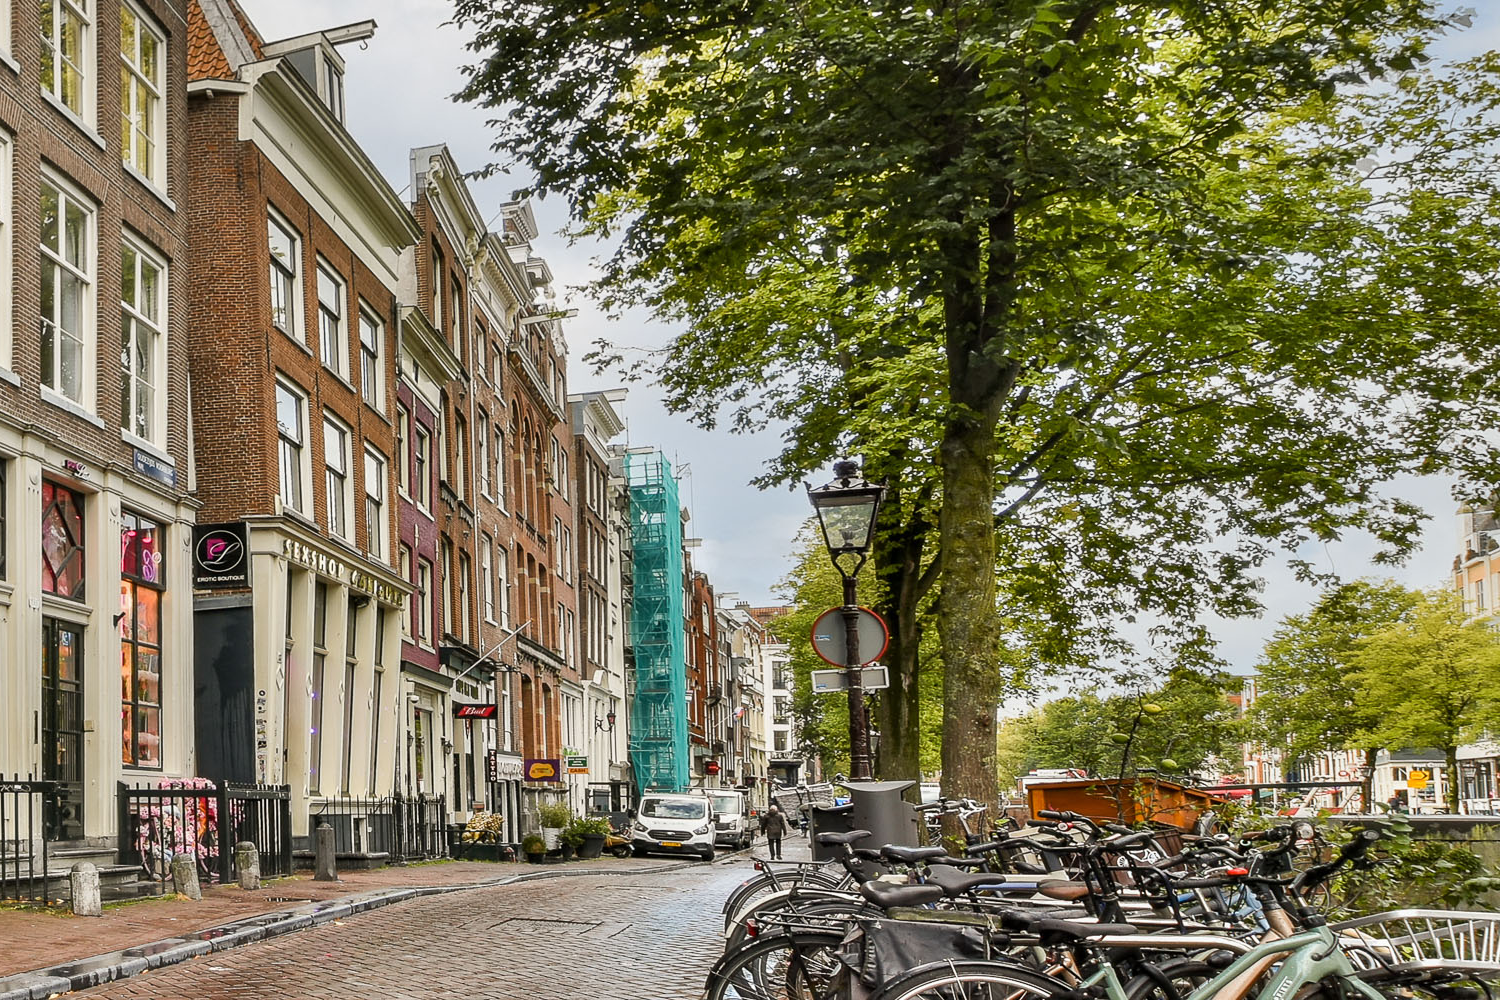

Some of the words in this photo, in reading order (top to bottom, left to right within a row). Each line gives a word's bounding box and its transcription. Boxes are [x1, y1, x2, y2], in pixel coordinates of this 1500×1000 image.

[284, 538, 345, 579] SEXSHOP
[217, 574, 245, 582] BOUTIQUE
[464, 706, 486, 715] Bud
[489, 750, 497, 782] TATTOO
